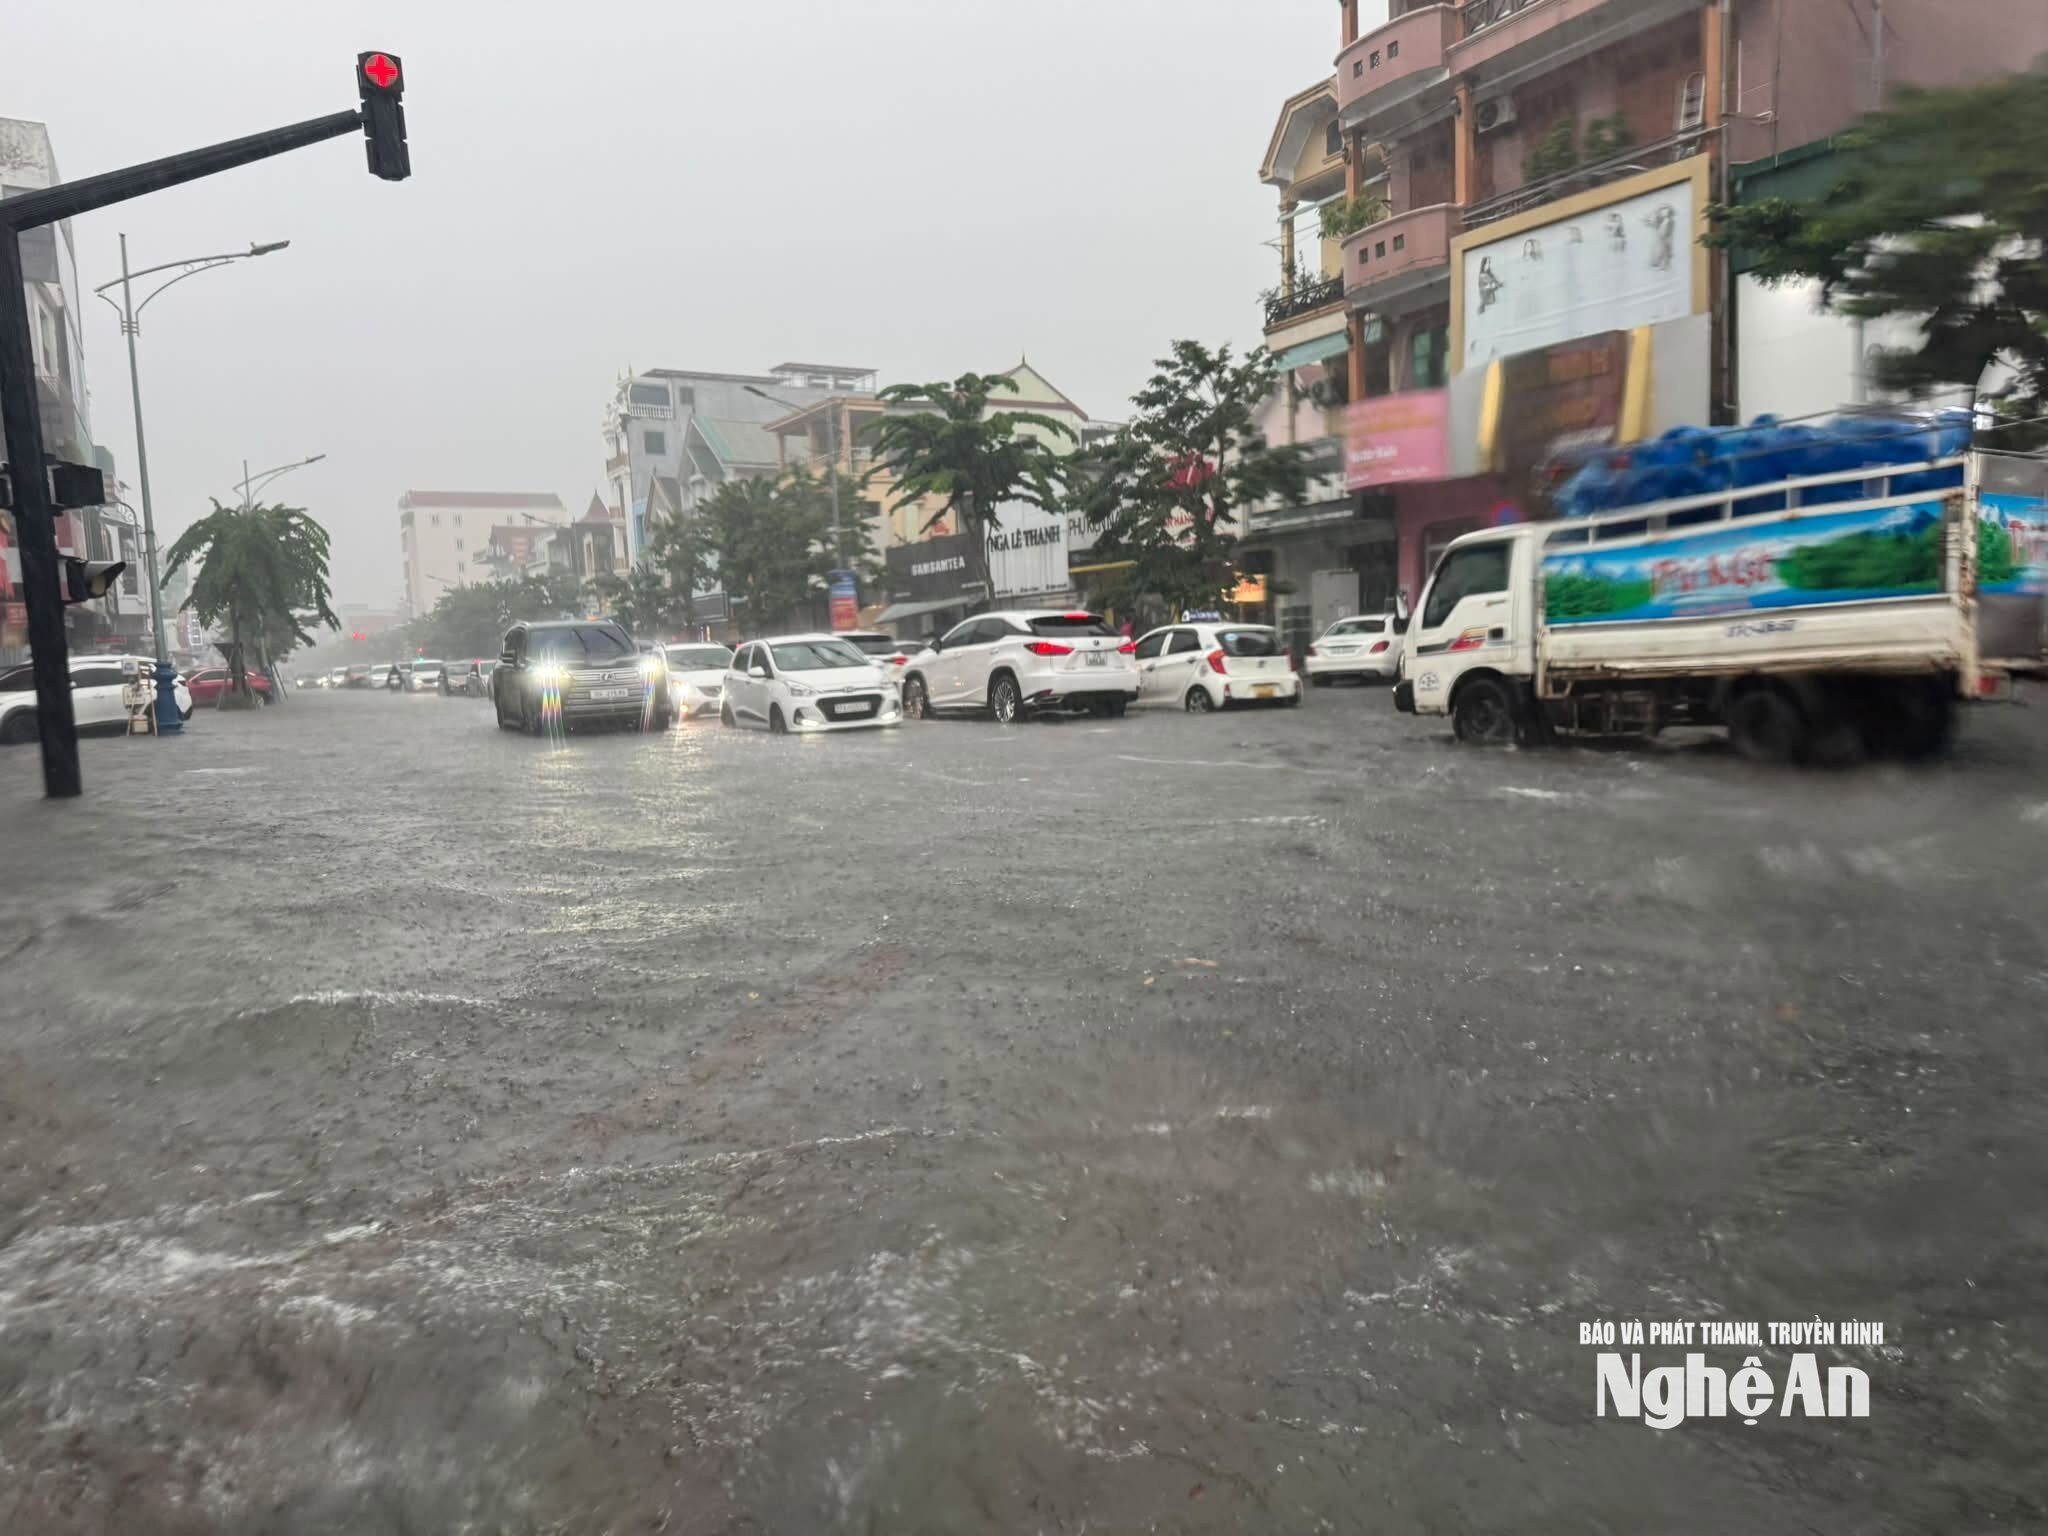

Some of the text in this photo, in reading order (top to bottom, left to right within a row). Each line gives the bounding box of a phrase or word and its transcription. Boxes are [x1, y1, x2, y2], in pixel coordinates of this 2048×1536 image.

[990, 525, 1061, 553] NGA LÊ THANH
